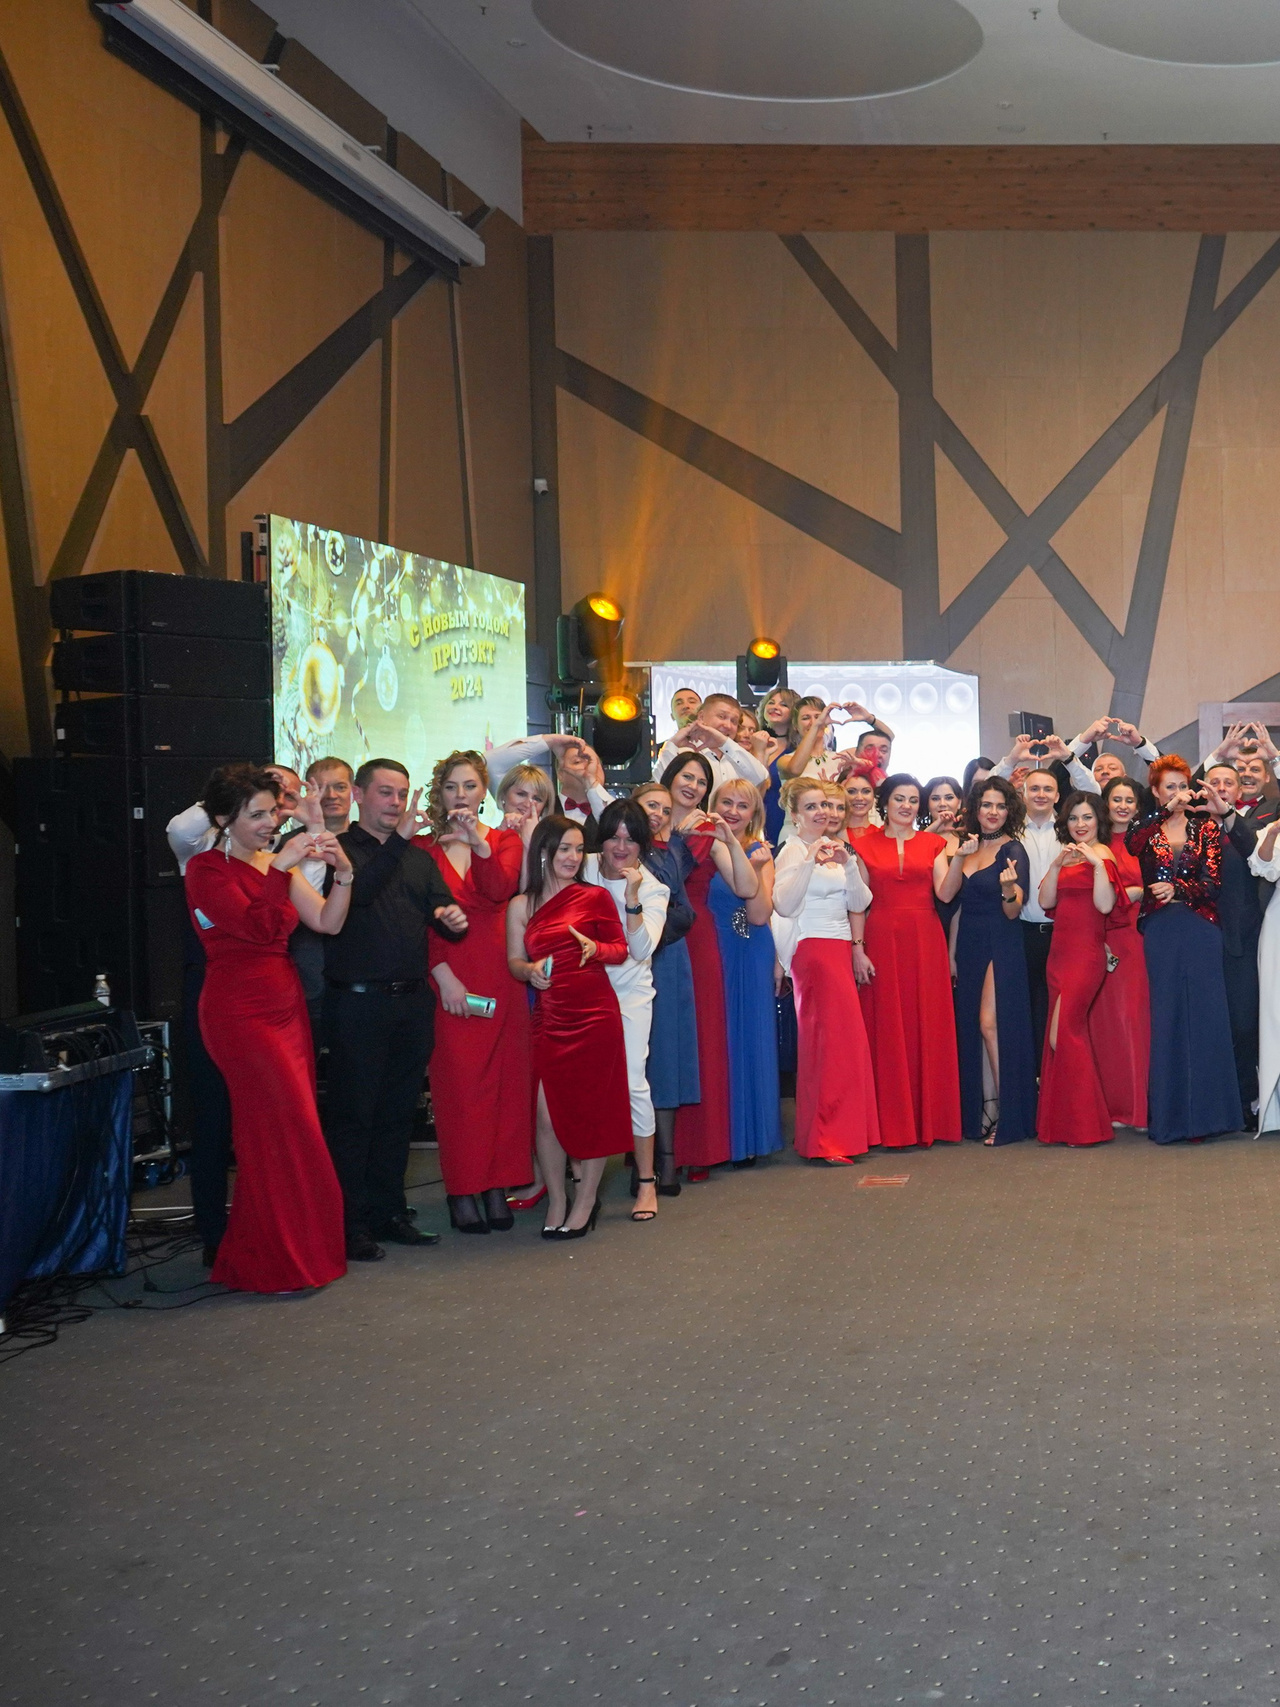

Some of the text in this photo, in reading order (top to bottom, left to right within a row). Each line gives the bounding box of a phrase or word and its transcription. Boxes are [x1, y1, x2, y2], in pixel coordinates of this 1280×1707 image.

[409, 624, 420, 648] С
[431, 639, 495, 672] ПРОТЭКТ
[450, 674, 483, 700] 2024
